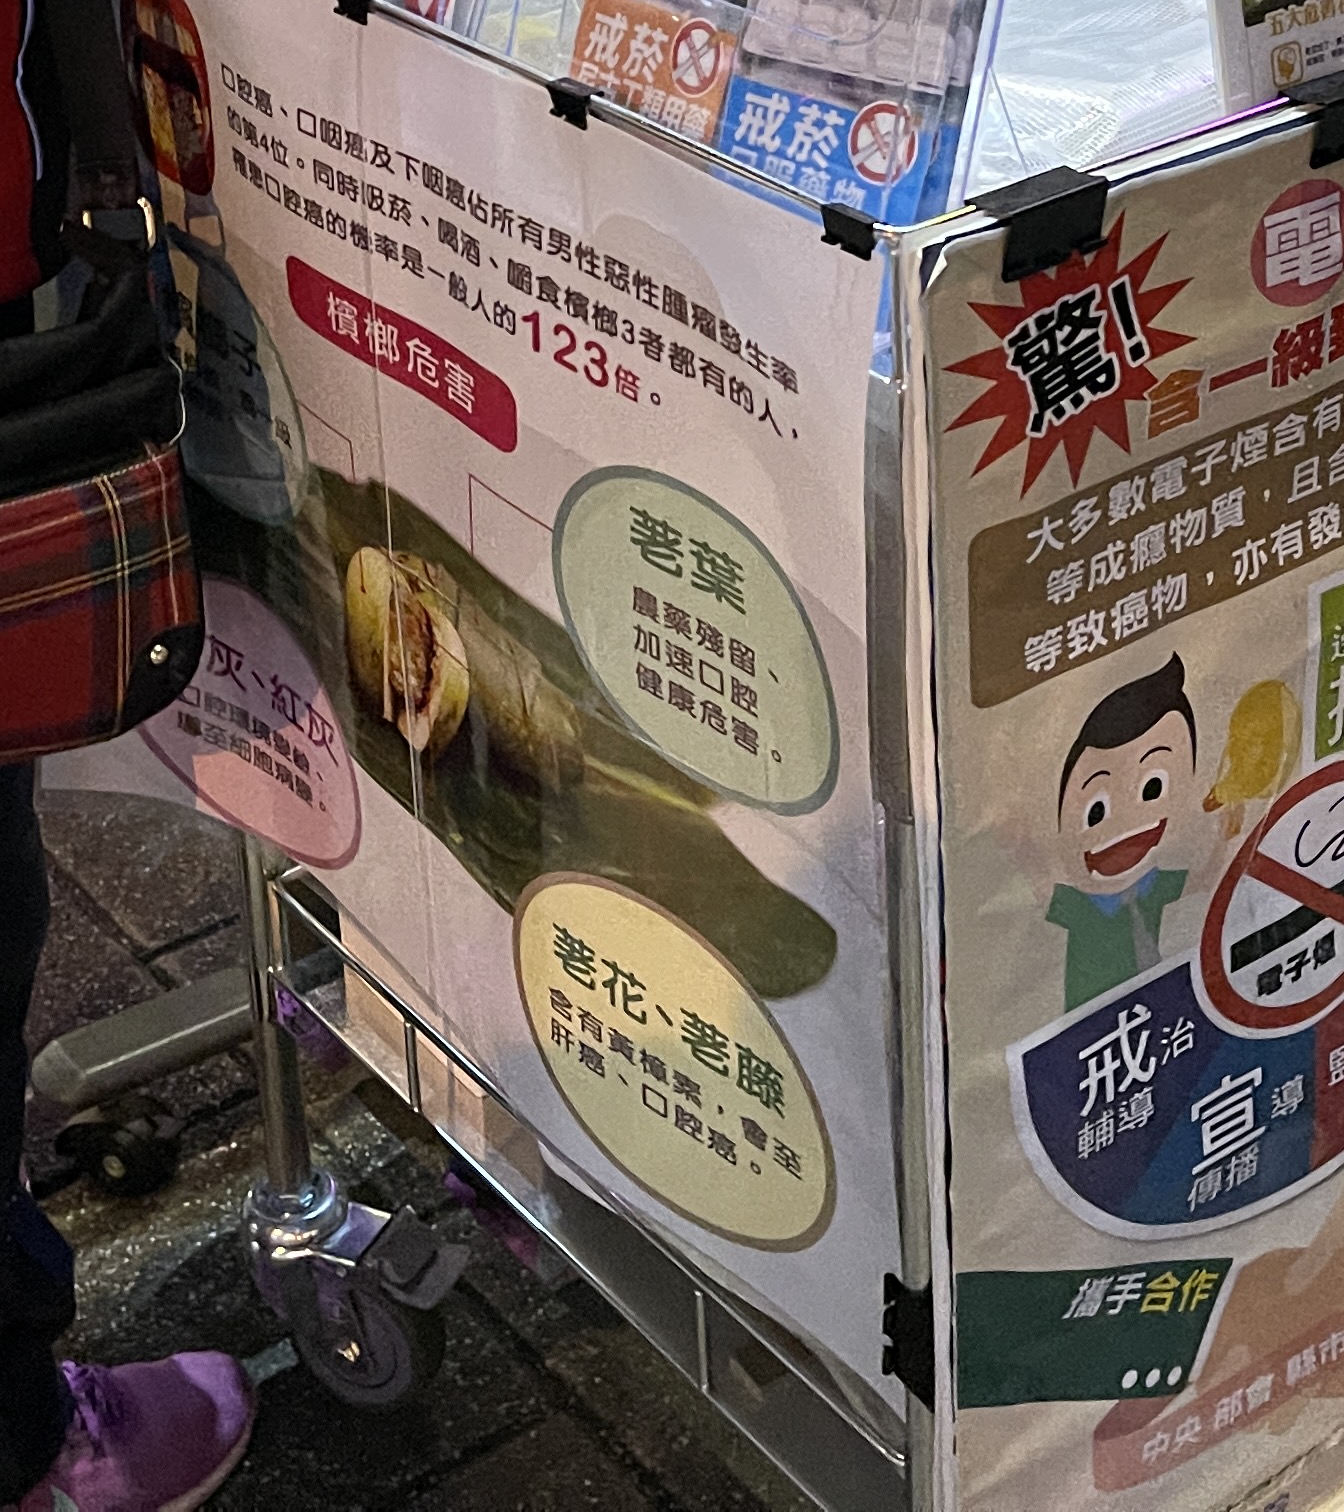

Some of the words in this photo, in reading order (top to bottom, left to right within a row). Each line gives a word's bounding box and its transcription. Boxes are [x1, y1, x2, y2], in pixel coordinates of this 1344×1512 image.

[584, 11, 669, 80] 戒菸
[738, 91, 847, 170] 戒菸
[327, 290, 476, 416] 檳榔危害
[633, 625, 759, 719] 加速口腔
[1061, 1267, 1221, 1322] 攜手合作
